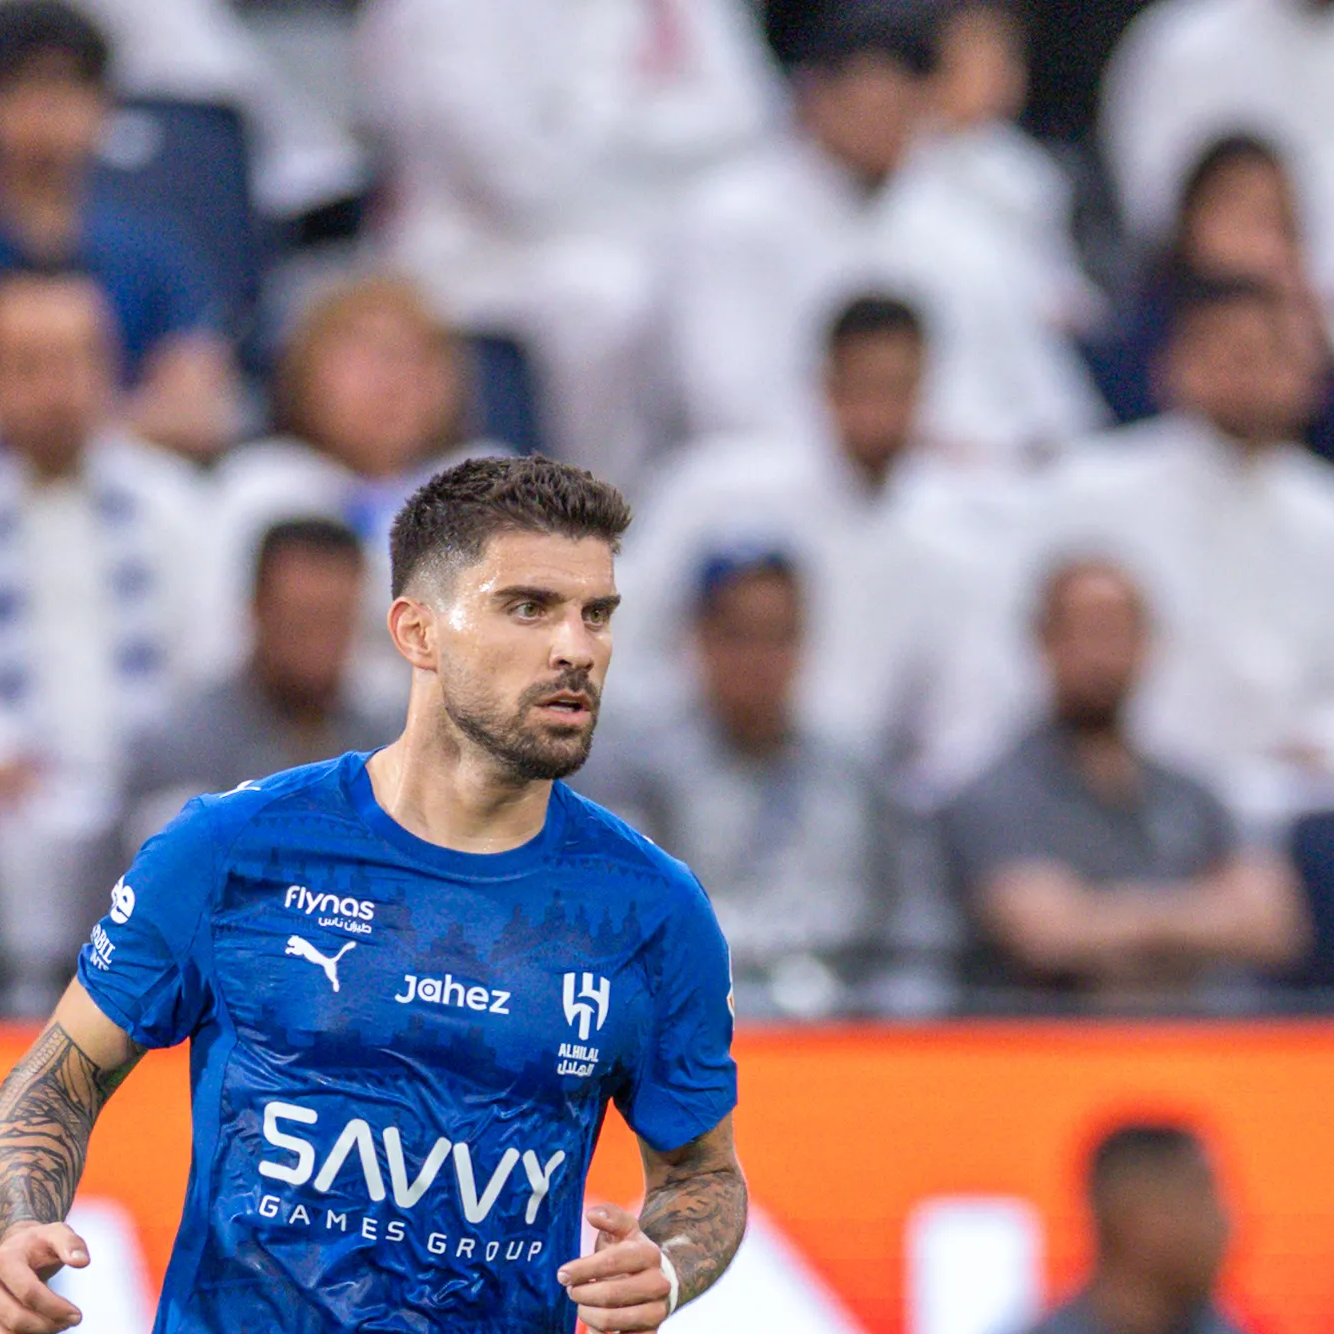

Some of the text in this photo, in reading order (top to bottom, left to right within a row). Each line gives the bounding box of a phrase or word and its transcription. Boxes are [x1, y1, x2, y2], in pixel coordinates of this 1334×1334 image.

[284, 885, 375, 920] flynas
[258, 1101, 566, 1225] SAVVY
[258, 1194, 543, 1262] GAMES GROUP
